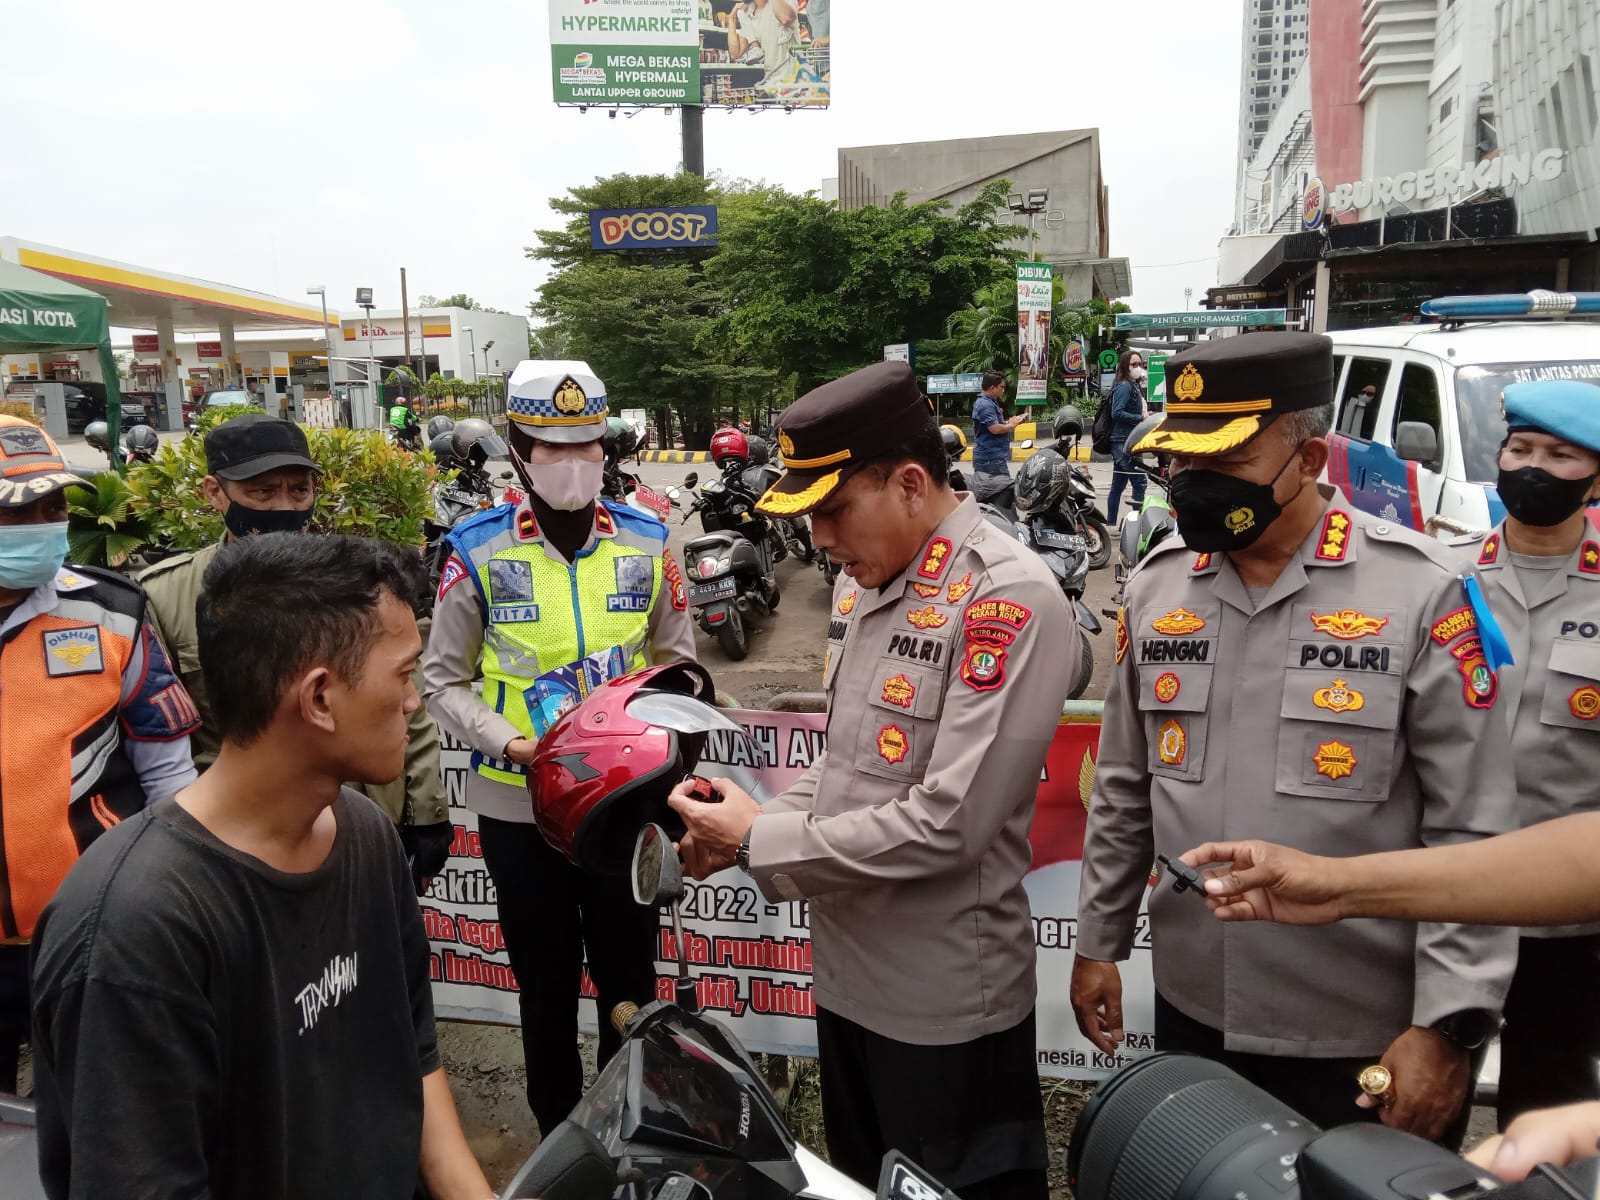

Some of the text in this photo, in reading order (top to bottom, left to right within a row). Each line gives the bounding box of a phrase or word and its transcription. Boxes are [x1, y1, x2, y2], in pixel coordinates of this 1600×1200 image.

[562, 15, 692, 33] HYPERMARKET
[607, 55, 692, 68] MEGA BEKASI
[615, 71, 689, 83] HYPERMALL
[572, 88, 606, 97] LANTAI
[642, 88, 686, 98] GROUND
[1335, 147, 1568, 212] BURGER KING
[600, 211, 707, 246] D'COST
[1018, 266, 1052, 279] DIBUKA
[33, 309, 77, 328] KOTA
[1152, 314, 1248, 325] PINTU CENDRAWASIH
[1513, 368, 1532, 384] SAT
[1532, 365, 1572, 382] LANTAS
[493, 606, 535, 621] VITA
[967, 601, 1026, 619] POLRES METRO
[1433, 612, 1465, 638] POLRES
[48, 631, 97, 647] DISHUB
[992, 629, 1009, 641] JAYA
[887, 634, 943, 664] POLRI
[1141, 639, 1210, 662] HENGKI
[1300, 643, 1390, 672] POLRI
[661, 928, 709, 964] kta
